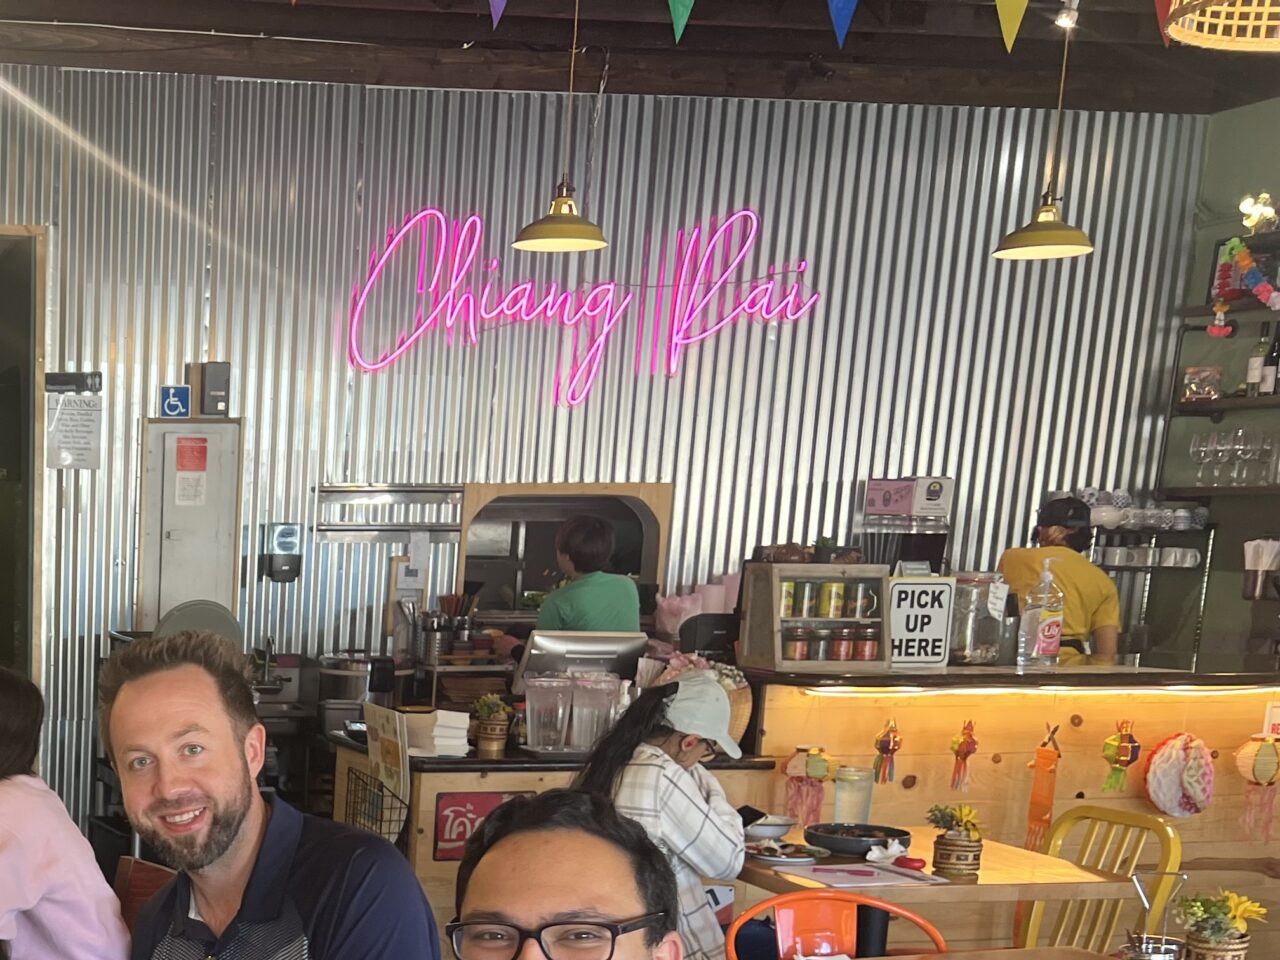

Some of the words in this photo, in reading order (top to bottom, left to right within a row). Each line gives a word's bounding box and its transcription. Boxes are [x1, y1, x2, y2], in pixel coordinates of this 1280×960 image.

[350, 207, 634, 407] Chiang
[896, 590, 945, 609] PICK
[905, 614, 932, 633] UP
[891, 638, 943, 657] HERE
